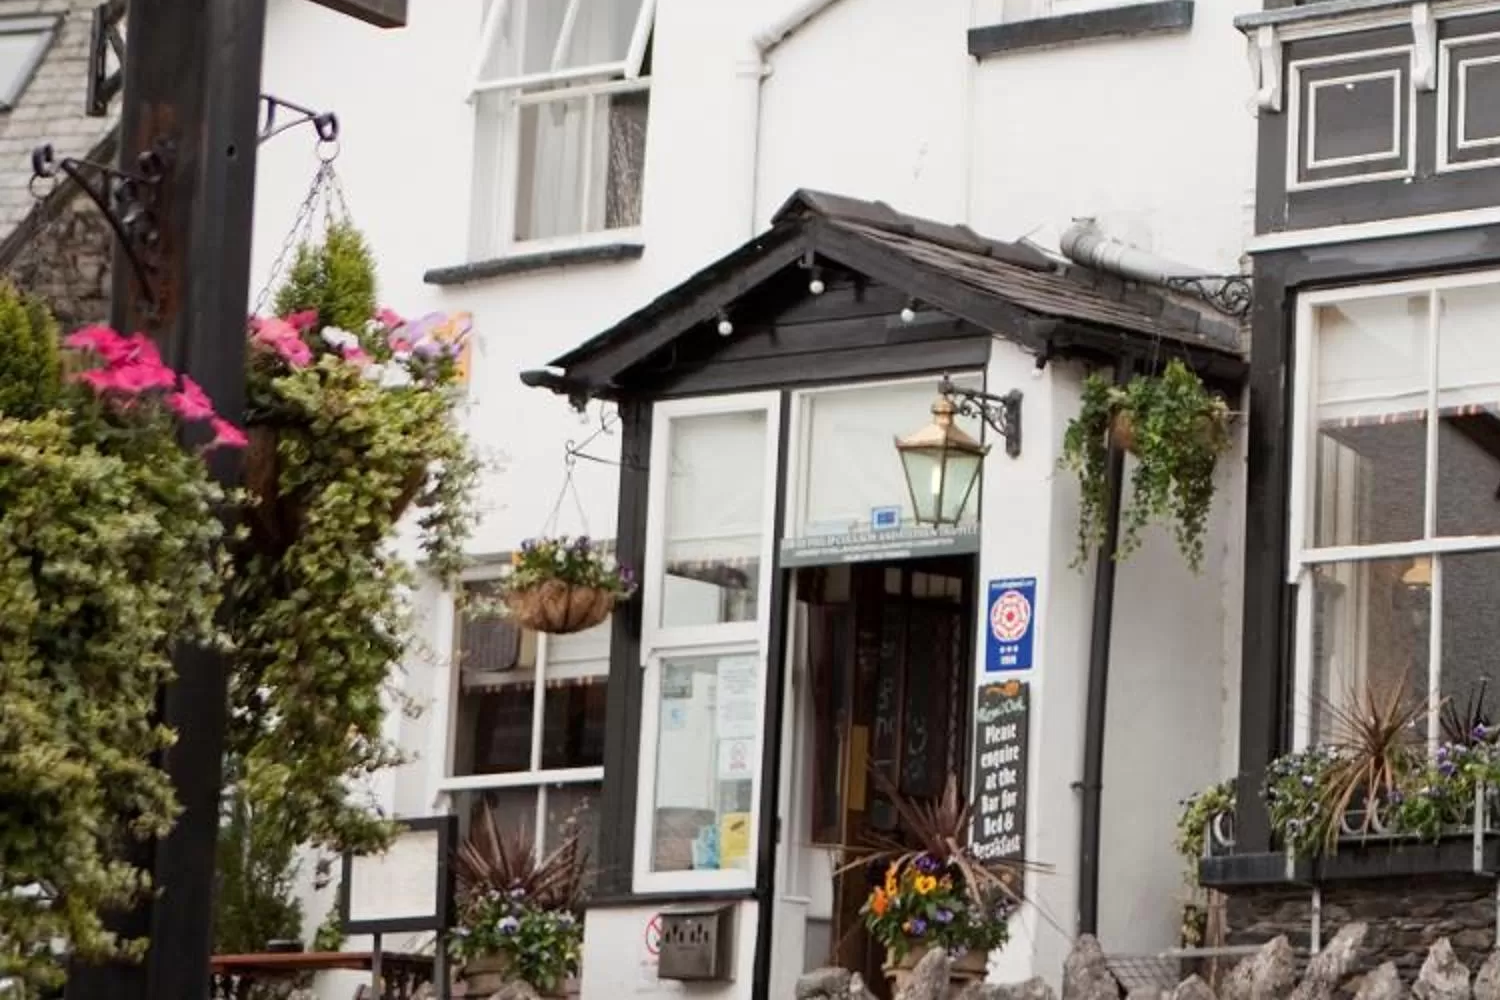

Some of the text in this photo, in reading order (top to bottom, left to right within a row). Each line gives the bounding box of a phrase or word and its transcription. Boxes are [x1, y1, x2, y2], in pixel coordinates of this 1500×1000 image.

[985, 723, 1017, 745] Please
[980, 744, 1020, 769] enquire
[985, 767, 1017, 790] at the
[1001, 789, 1018, 810] for
